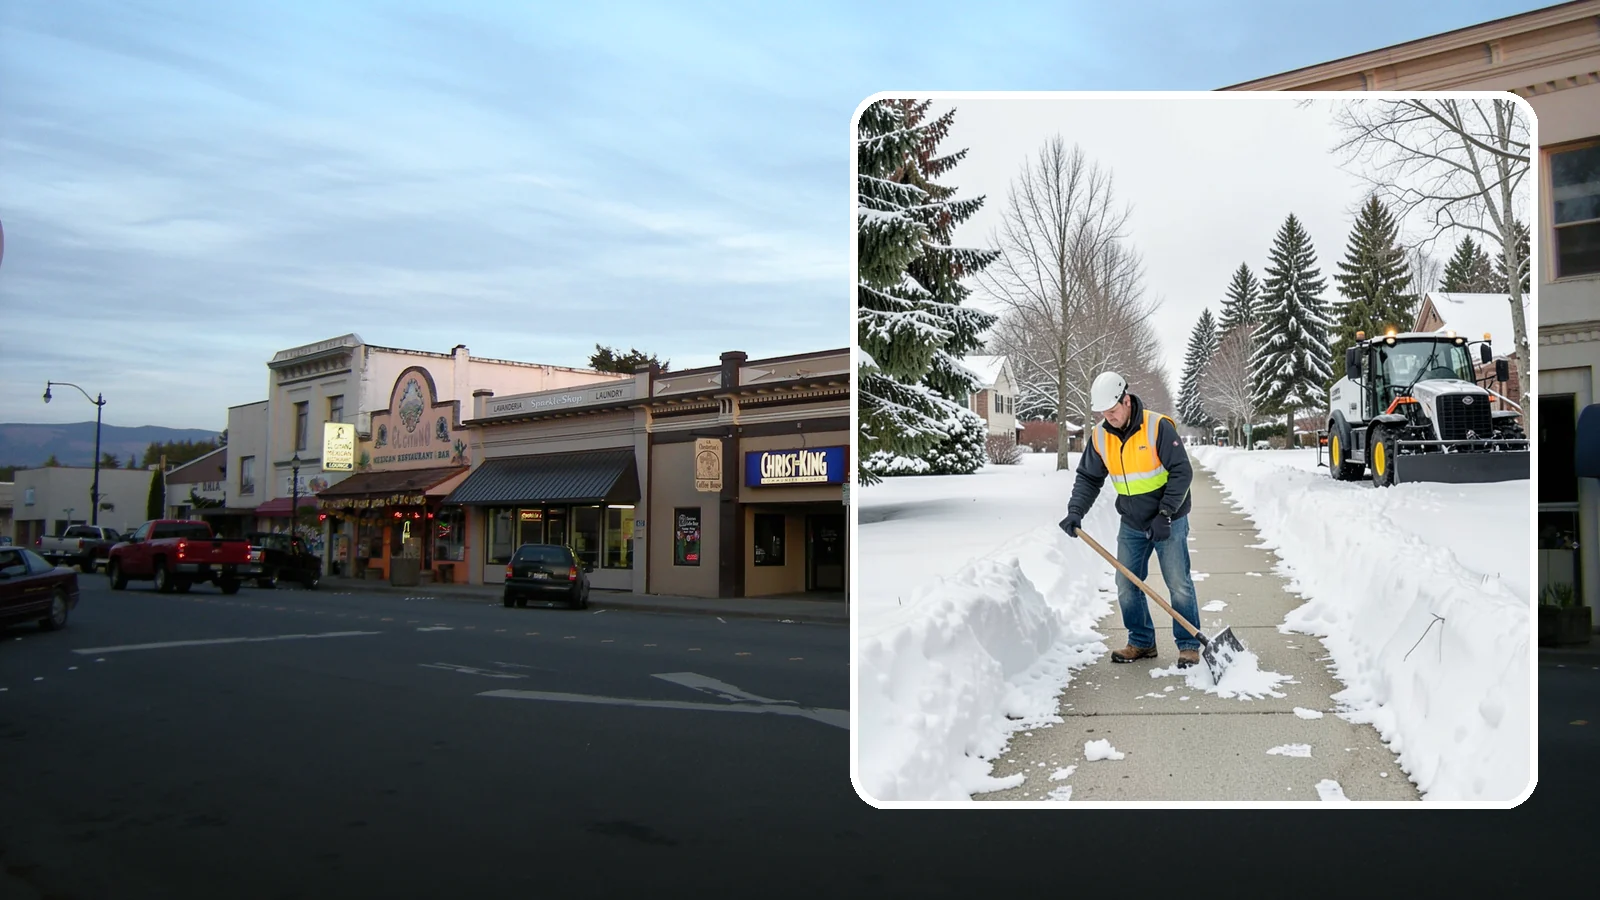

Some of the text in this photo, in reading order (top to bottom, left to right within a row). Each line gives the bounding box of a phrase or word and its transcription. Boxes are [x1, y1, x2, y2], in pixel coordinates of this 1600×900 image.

[494, 402, 522, 412] LAVANDERIA
[595, 389, 623, 400] LAUNDRY
[398, 452, 433, 462] RESTAURANT
[438, 450, 450, 459] BAR
[761, 450, 827, 478] CHRIST KING
